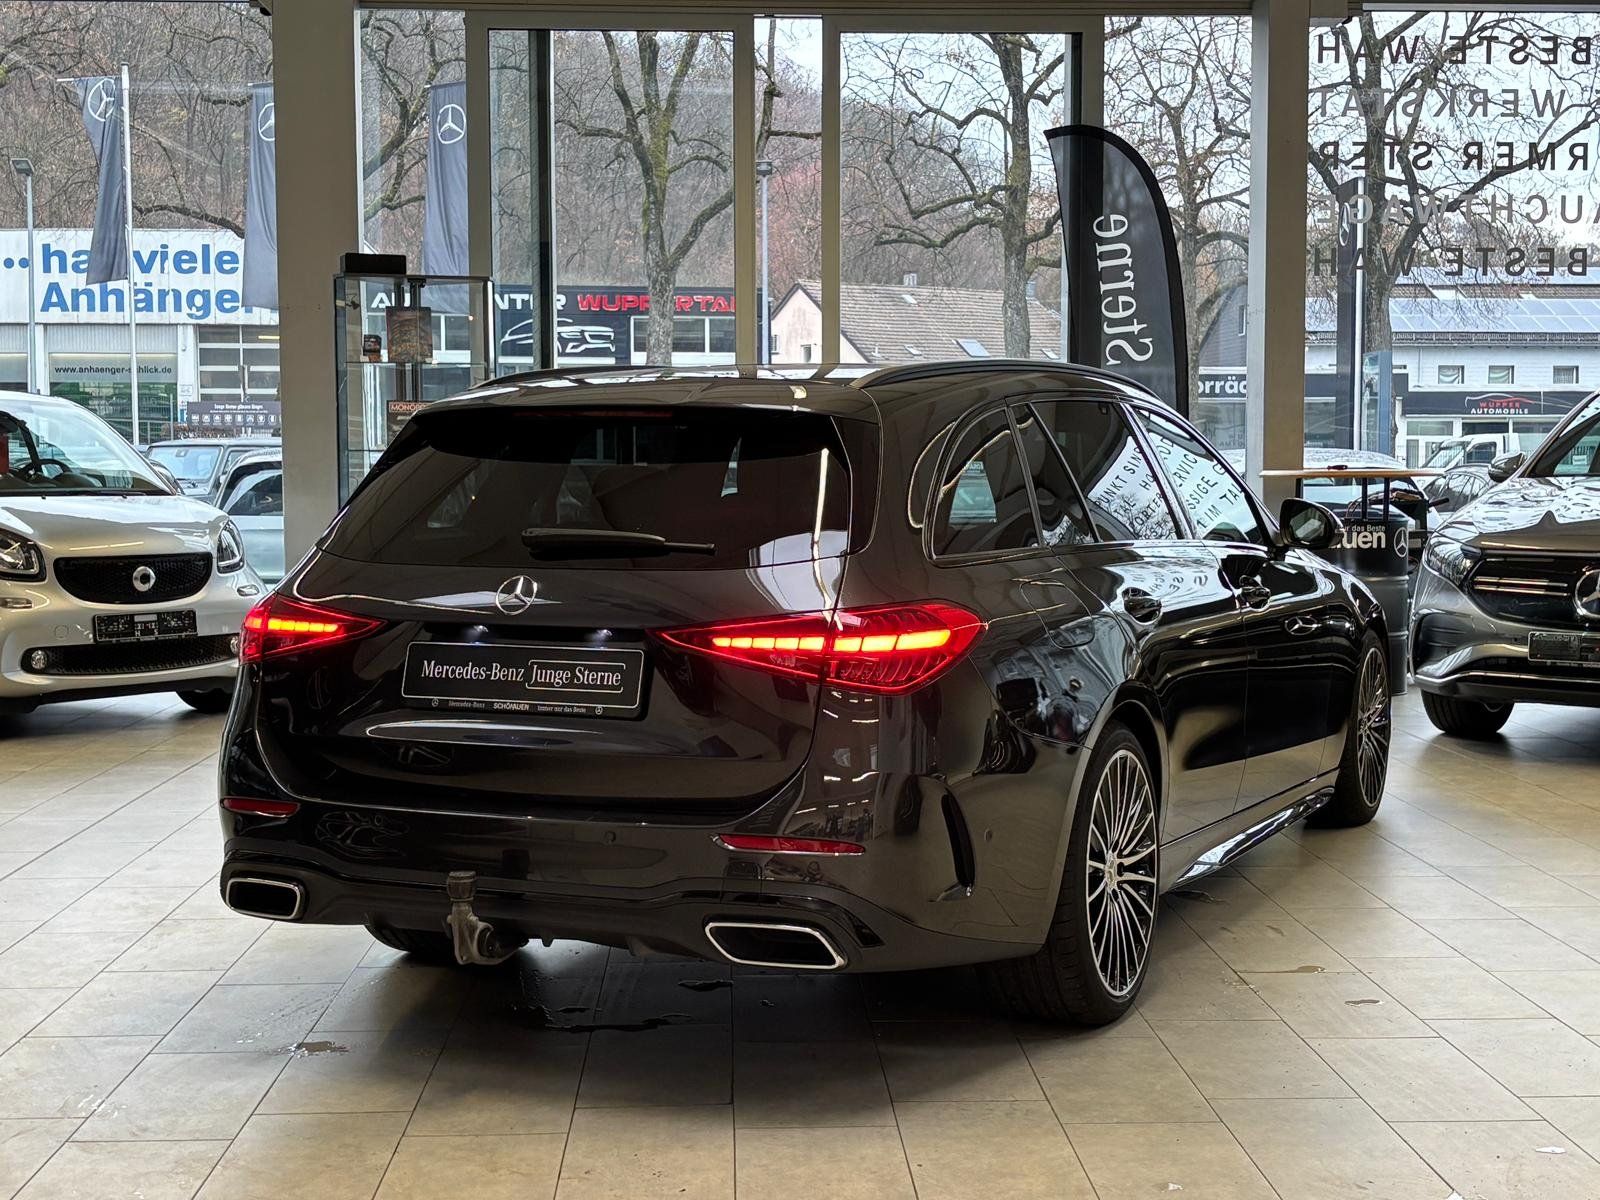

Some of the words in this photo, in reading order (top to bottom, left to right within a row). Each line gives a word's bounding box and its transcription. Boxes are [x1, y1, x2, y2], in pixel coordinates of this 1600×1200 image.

[42, 243, 92, 274] ha
[132, 243, 240, 275] viele
[40, 281, 254, 320] Anhänge
[577, 294, 736, 312] WUPPRTA
[54, 365, 172, 375] www.anhaenger-shlick.de
[1366, 524, 1386, 532] Beste
[1329, 531, 1386, 549] uen
[421, 660, 524, 682] Mercedes-Benz
[530, 664, 571, 687] Junge
[574, 666, 621, 686] Sterne
